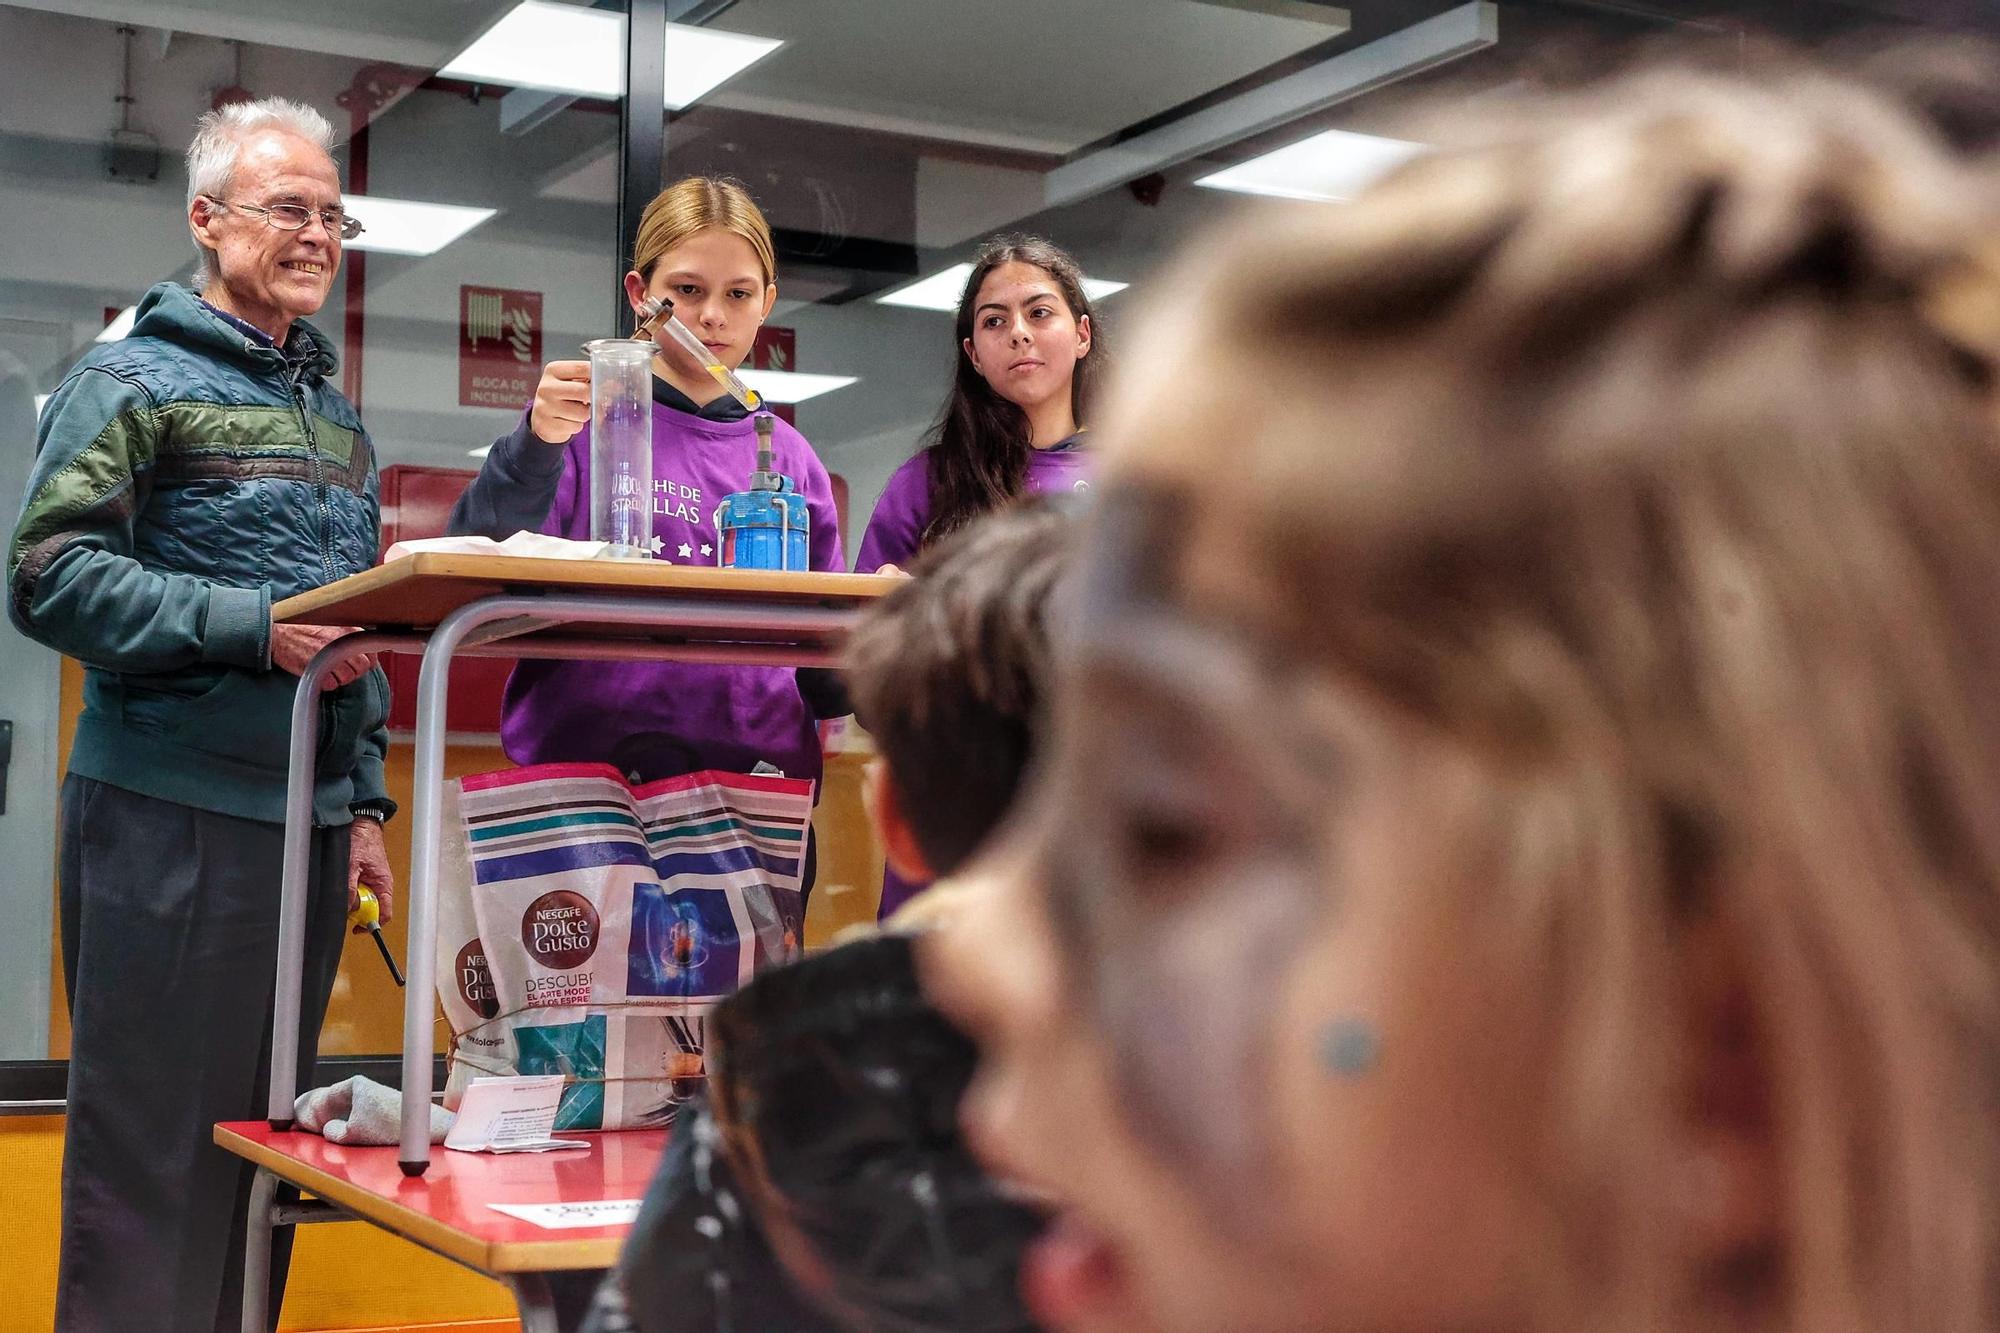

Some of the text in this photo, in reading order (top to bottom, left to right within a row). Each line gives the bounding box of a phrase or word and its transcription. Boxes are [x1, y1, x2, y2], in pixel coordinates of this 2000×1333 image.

[472, 376, 528, 391] BOCA DE
[680, 484, 701, 503] DE
[533, 920, 590, 938] Dolce
[536, 935, 590, 953] Gusto
[540, 990, 562, 999] ARTE
[560, 995, 591, 1006] ESPRE
